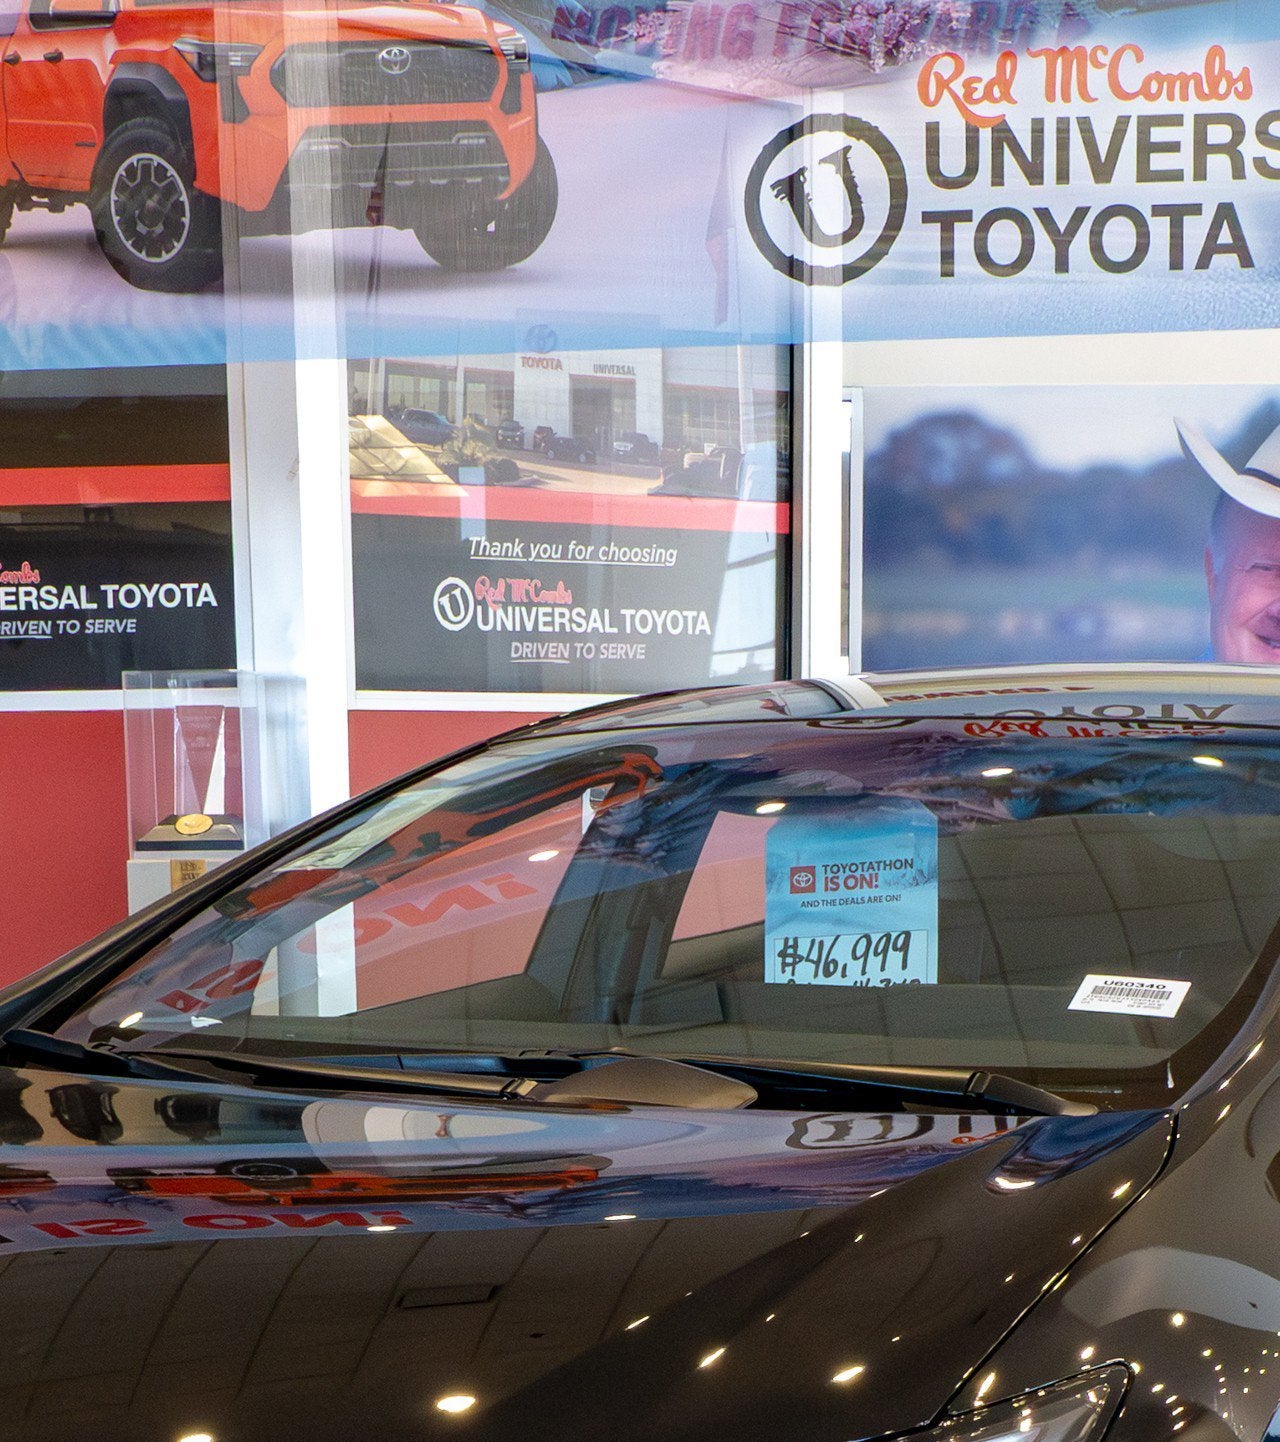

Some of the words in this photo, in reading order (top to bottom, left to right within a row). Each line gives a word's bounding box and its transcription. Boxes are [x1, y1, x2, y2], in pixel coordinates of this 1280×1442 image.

[917, 52, 1018, 128] Red
[1026, 44, 1253, 106] McCombs
[921, 201, 1256, 279] TOYOTA
[469, 537, 524, 558] Thank
[528, 543, 561, 562] you
[568, 540, 595, 559] for
[598, 543, 678, 566] choosing
[99, 582, 218, 608] TOYOTA
[56, 619, 81, 634] TO
[84, 618, 137, 634] SERVE
[476, 606, 618, 634] UNIVERSAL
[620, 609, 711, 636] TOYOTA
[510, 641, 570, 660] DRIVEN
[574, 642, 596, 659] TO
[599, 642, 646, 660] SERVE
[822, 858, 914, 876] TOYOTATHON
[824, 876, 841, 893] IS
[843, 873, 880, 891] ON!
[800, 899, 821, 909] AND
[821, 898, 838, 907] THE
[838, 896, 866, 906] DEALS
[867, 896, 884, 904] ARE
[885, 894, 902, 903] ON!
